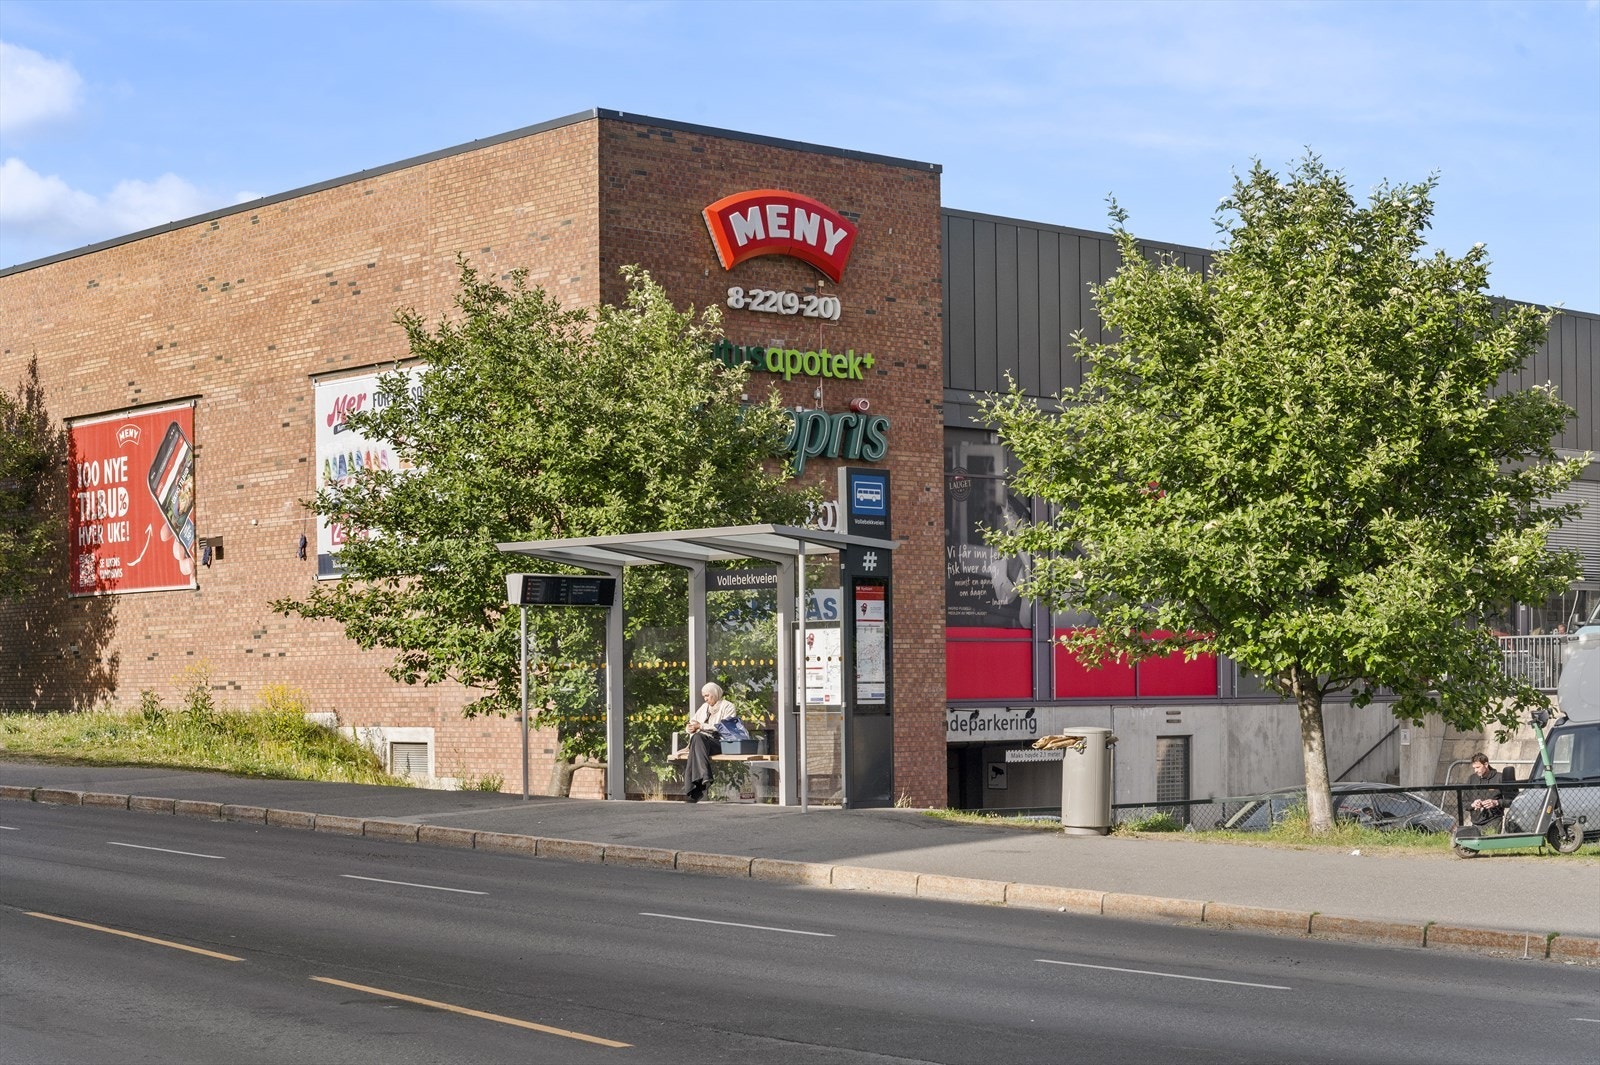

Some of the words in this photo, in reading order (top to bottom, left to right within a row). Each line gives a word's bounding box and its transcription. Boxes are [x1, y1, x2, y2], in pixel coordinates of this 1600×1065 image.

[728, 204, 848, 256] MENY
[727, 286, 842, 321] 8-22(9-20)
[326, 392, 367, 428] Mer
[119, 429, 139, 440] MENY
[77, 461, 100, 488] 100
[103, 456, 128, 485] NYE
[77, 487, 130, 521] TILBUD
[78, 525, 104, 546] HVER
[107, 522, 130, 543] UKE!
[947, 545, 955, 559] Vi
[959, 544, 972, 563] får
[974, 547, 987, 559] inn
[717, 572, 778, 586] Vollebekkveien
[947, 561, 960, 579] fisk
[962, 561, 979, 574] hver
[970, 587, 987, 599] dagen
[992, 596, 1008, 610] Ingrid
[946, 713, 1037, 735] deparkering
